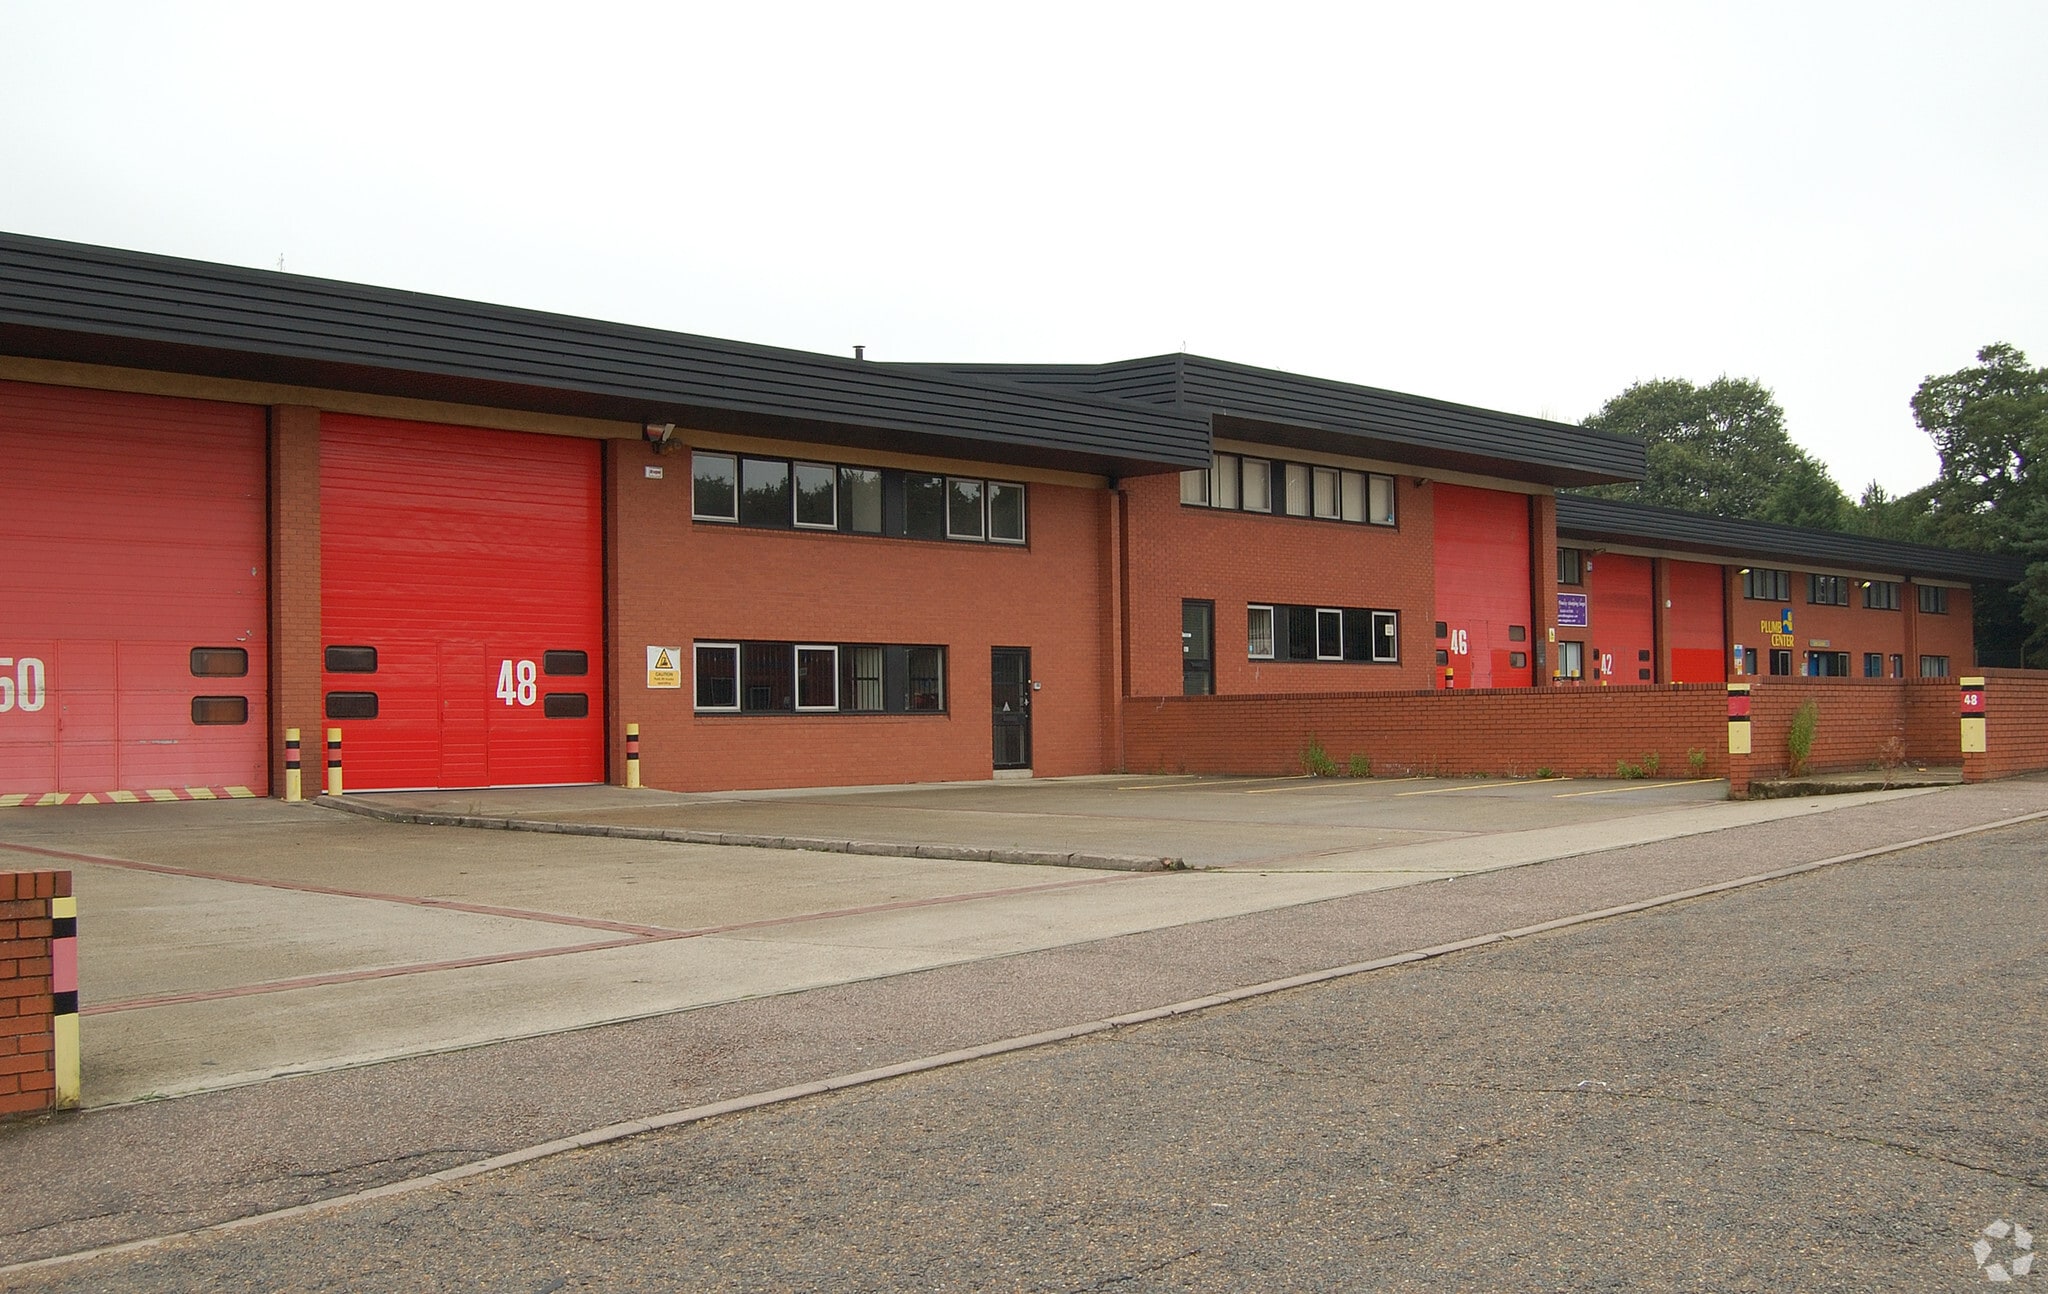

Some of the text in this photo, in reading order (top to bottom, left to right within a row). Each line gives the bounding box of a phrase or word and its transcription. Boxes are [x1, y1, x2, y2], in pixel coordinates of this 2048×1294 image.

[1760, 619, 1782, 634] PLUMB
[1450, 629, 1468, 655] 46
[1771, 633, 1794, 647] CENTER
[1601, 653, 1612, 675] 42
[496, 659, 537, 706] 48
[1964, 694, 1978, 706] 48
